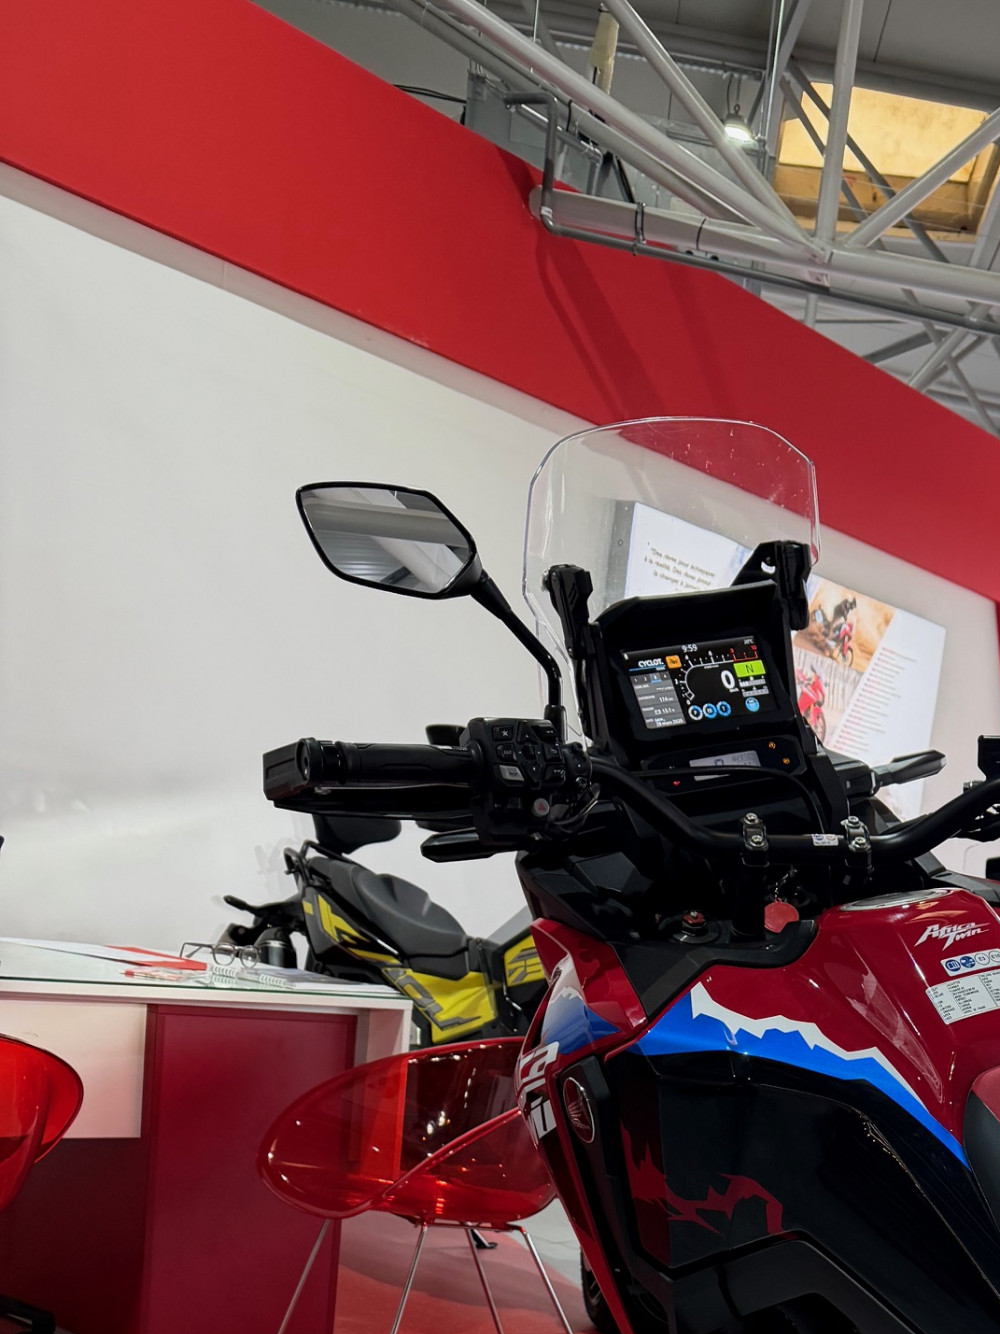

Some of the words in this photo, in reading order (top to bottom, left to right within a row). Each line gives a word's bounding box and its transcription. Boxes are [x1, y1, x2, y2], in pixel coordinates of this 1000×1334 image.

[682, 644, 698, 653] 9:59
[745, 664, 754, 673] N
[721, 670, 735, 689] 0
[914, 922, 990, 947] Africa
[942, 928, 989, 951] Twin
